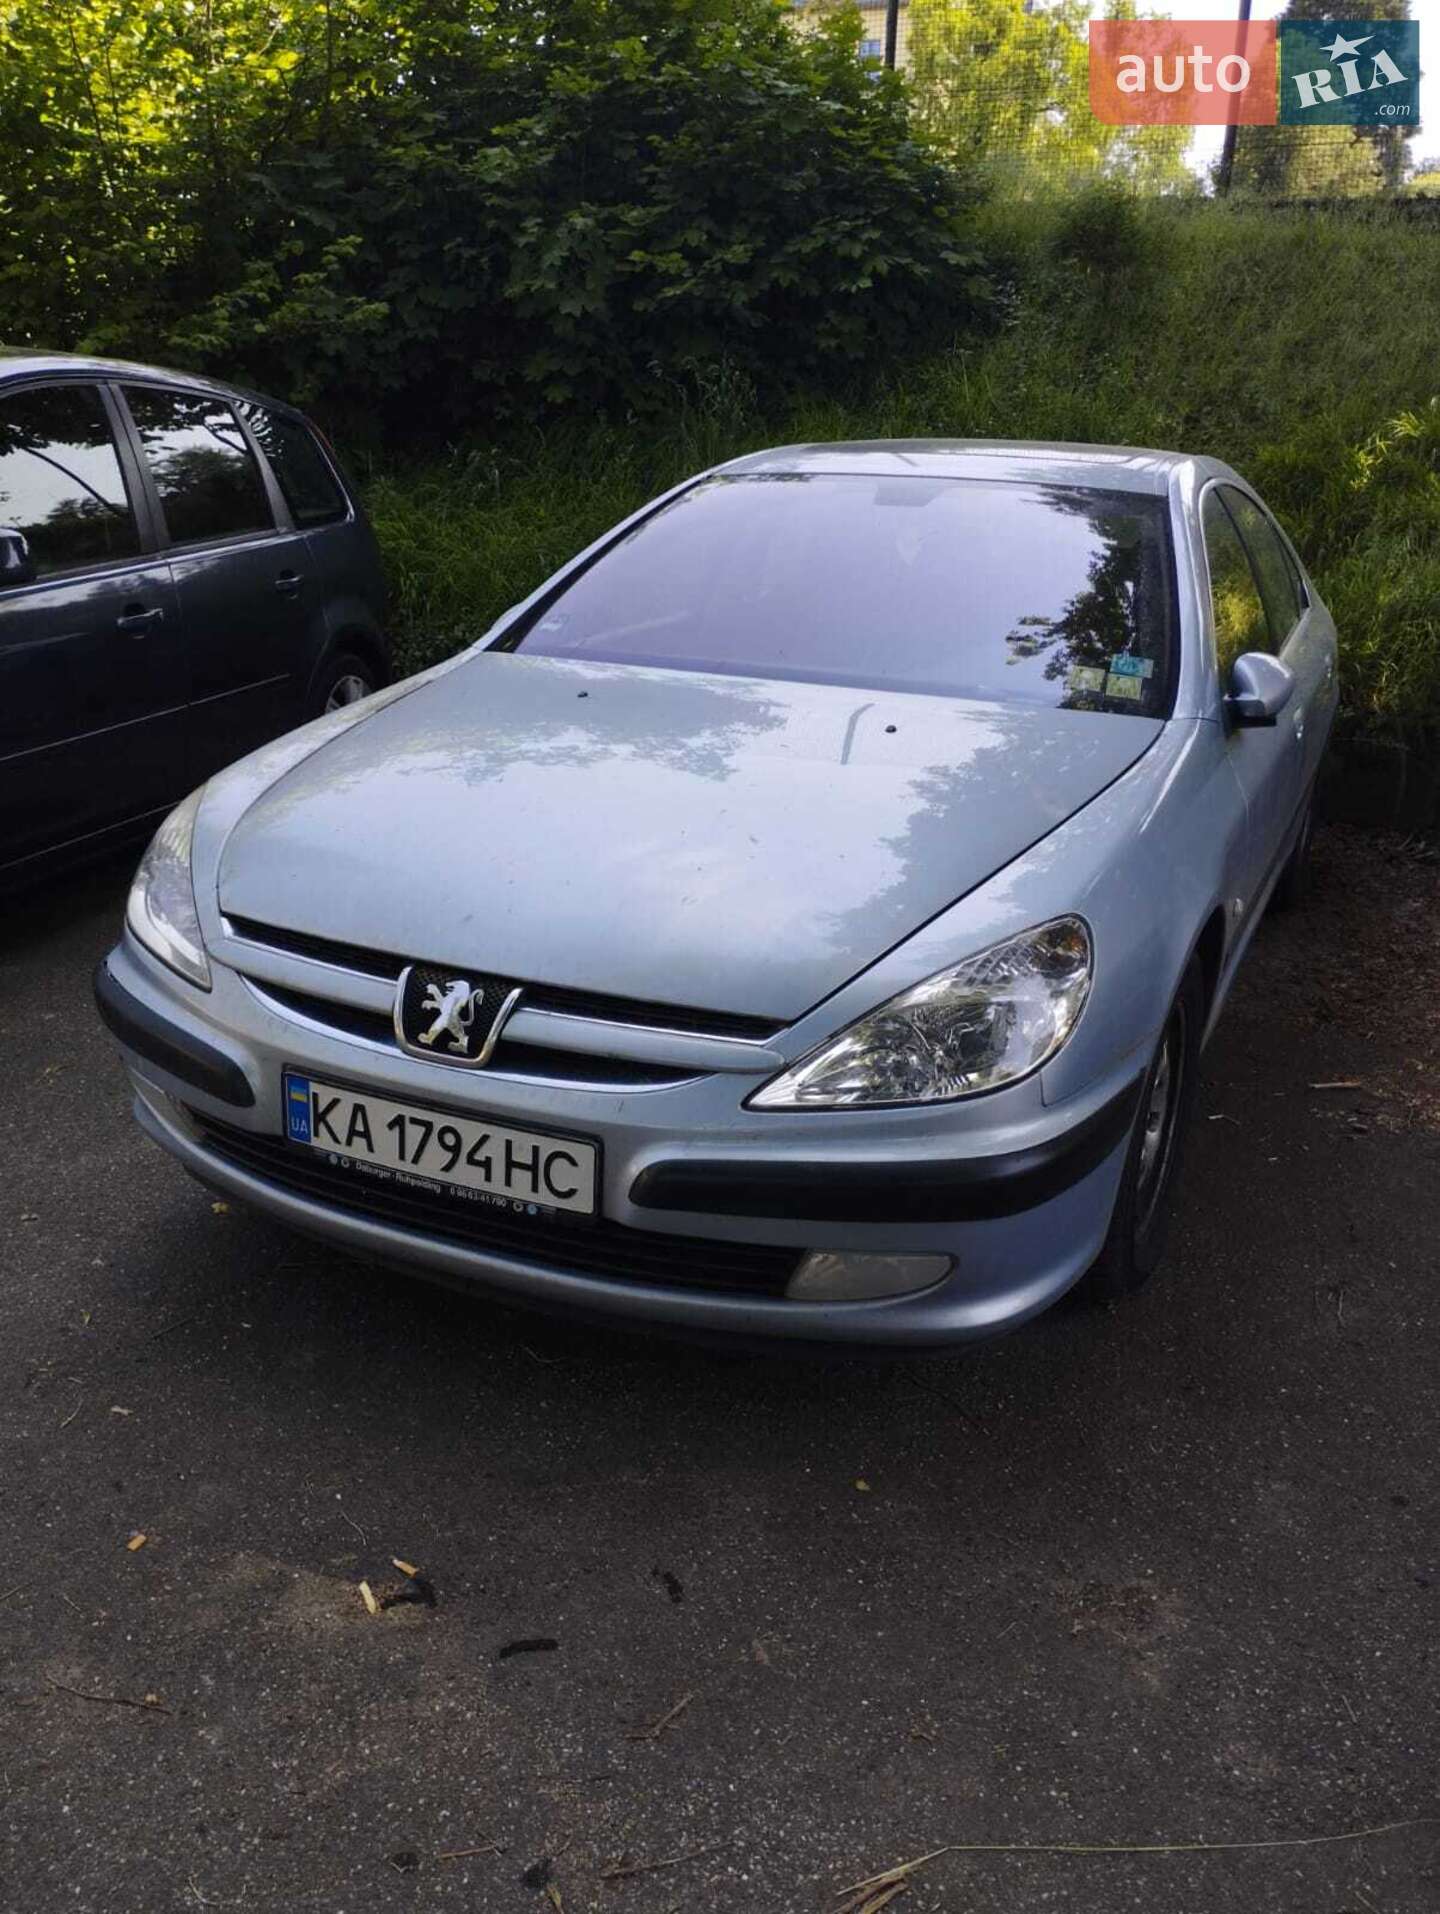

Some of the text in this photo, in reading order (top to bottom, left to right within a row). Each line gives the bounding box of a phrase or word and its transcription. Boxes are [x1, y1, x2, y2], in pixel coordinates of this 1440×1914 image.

[290, 1116, 309, 1135] UA
[312, 1091, 579, 1199] KA 1794 HC
